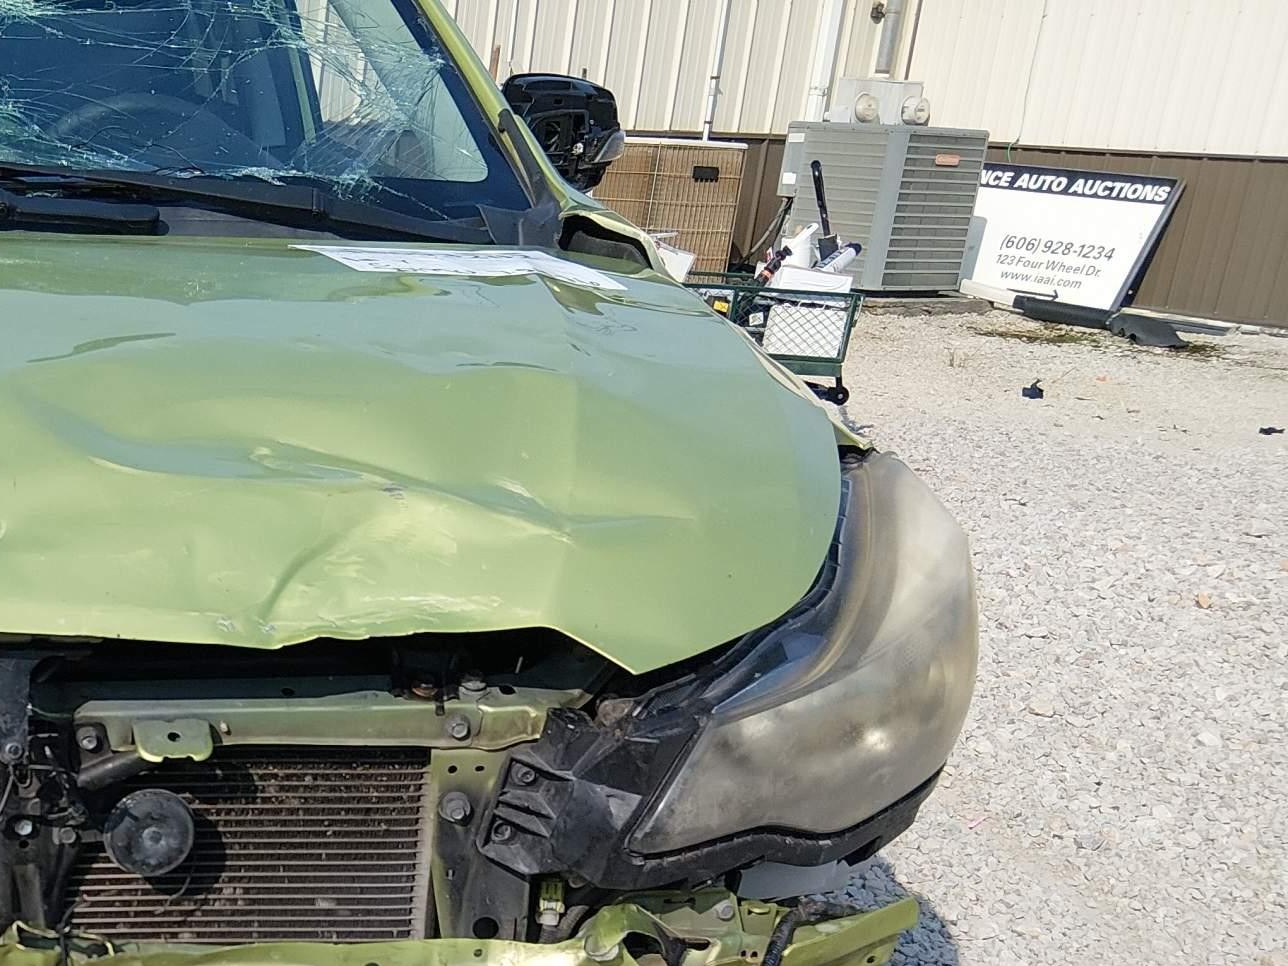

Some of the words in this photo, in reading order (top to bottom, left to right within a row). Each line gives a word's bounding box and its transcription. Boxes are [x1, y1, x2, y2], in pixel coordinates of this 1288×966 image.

[1013, 173, 1068, 193] AUTO
[1068, 178, 1172, 202] AUCTIONS
[1000, 234, 1042, 254] (606)
[1041, 239, 1116, 261] 928-1234
[996, 254, 1016, 266] 123
[1015, 256, 1044, 270] Four
[1045, 260, 1086, 275] Wheel
[1085, 265, 1102, 277] Dr.
[1000, 270, 1082, 289] www.iaai.com
